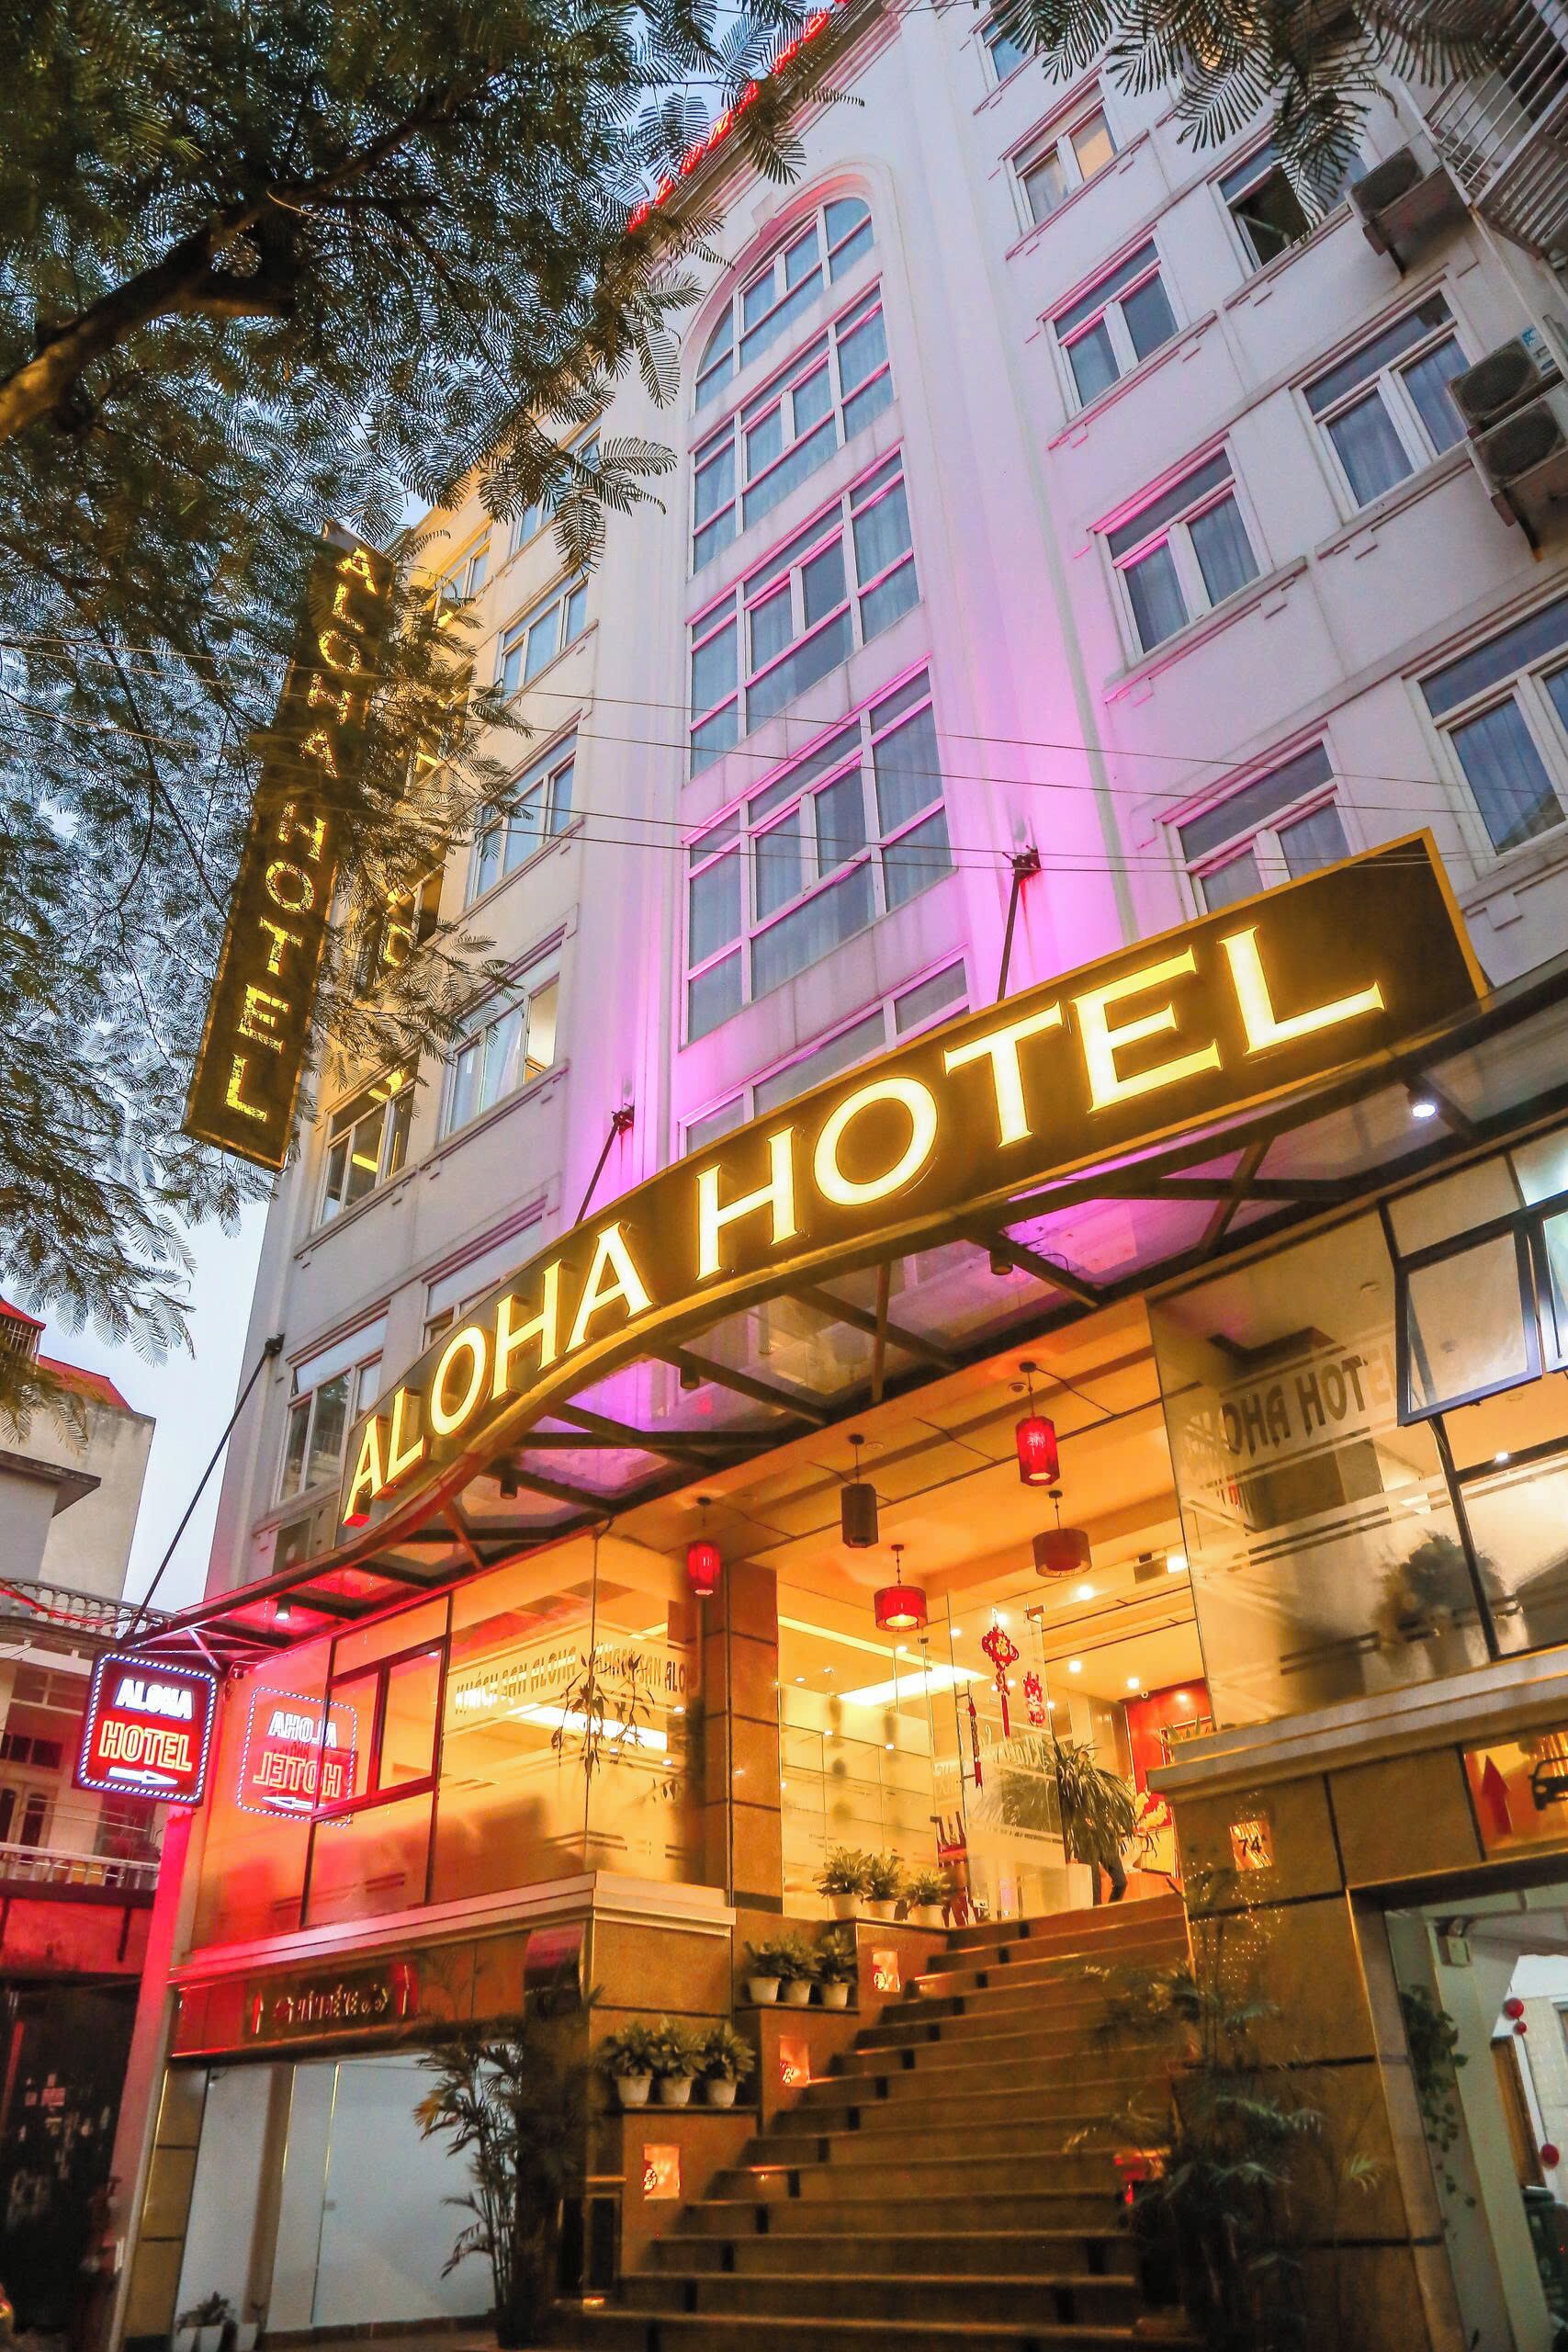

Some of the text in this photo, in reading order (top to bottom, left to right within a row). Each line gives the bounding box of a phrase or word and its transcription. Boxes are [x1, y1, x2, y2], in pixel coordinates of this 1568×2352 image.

[224, 547, 378, 1123] ALOHA HOTEL
[341, 926, 1385, 1527] ALOHA HOTEL
[98, 1720, 193, 1773] HOTEL
[114, 1678, 193, 1721] ALOHA
